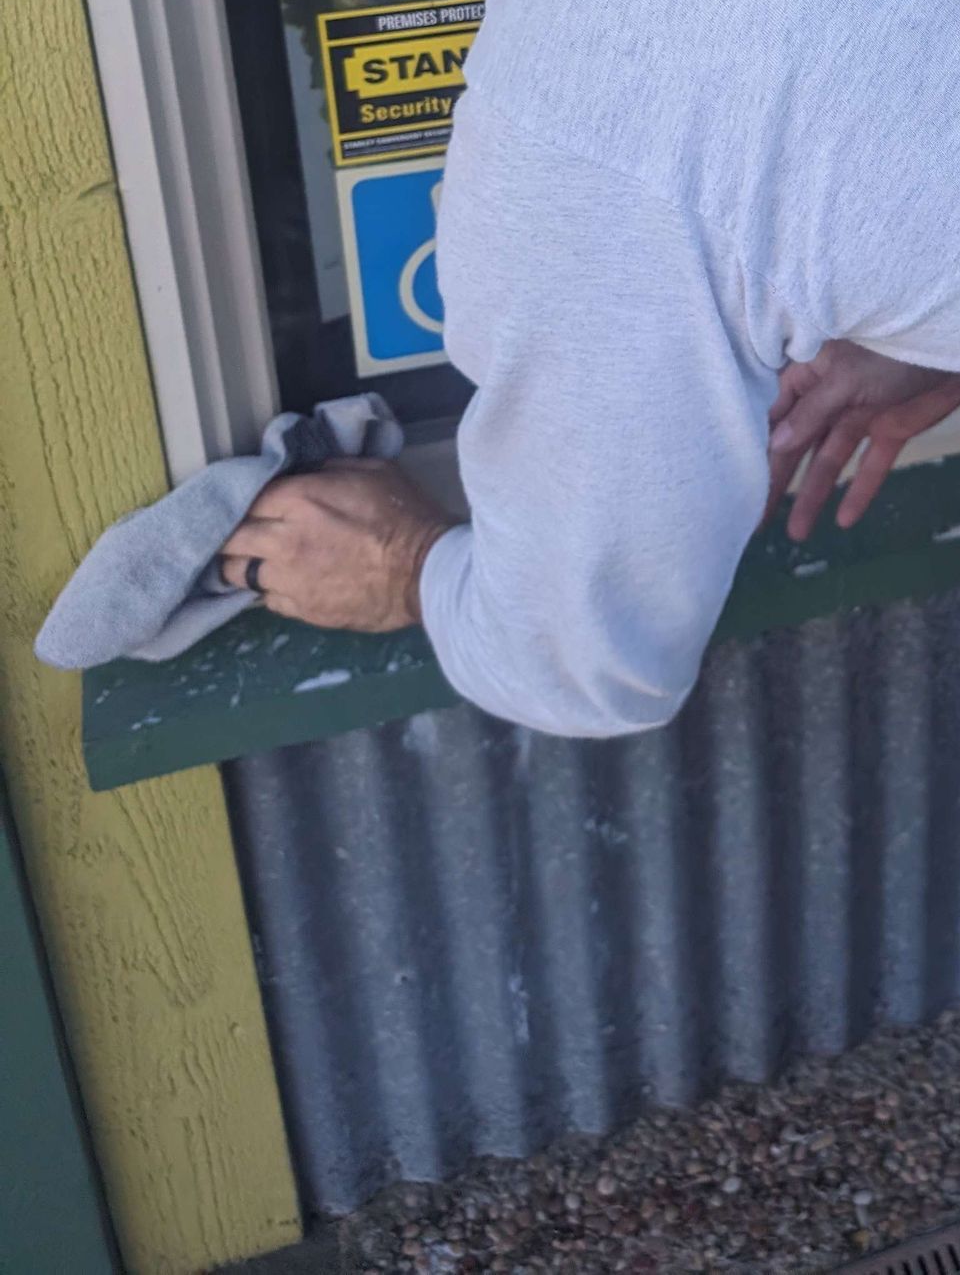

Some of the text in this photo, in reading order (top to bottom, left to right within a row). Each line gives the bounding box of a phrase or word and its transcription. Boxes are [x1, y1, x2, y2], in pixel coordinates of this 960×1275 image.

[378, 4, 486, 31] PREMISES PROTEC
[362, 47, 469, 84] STAN
[360, 96, 452, 124] Security
